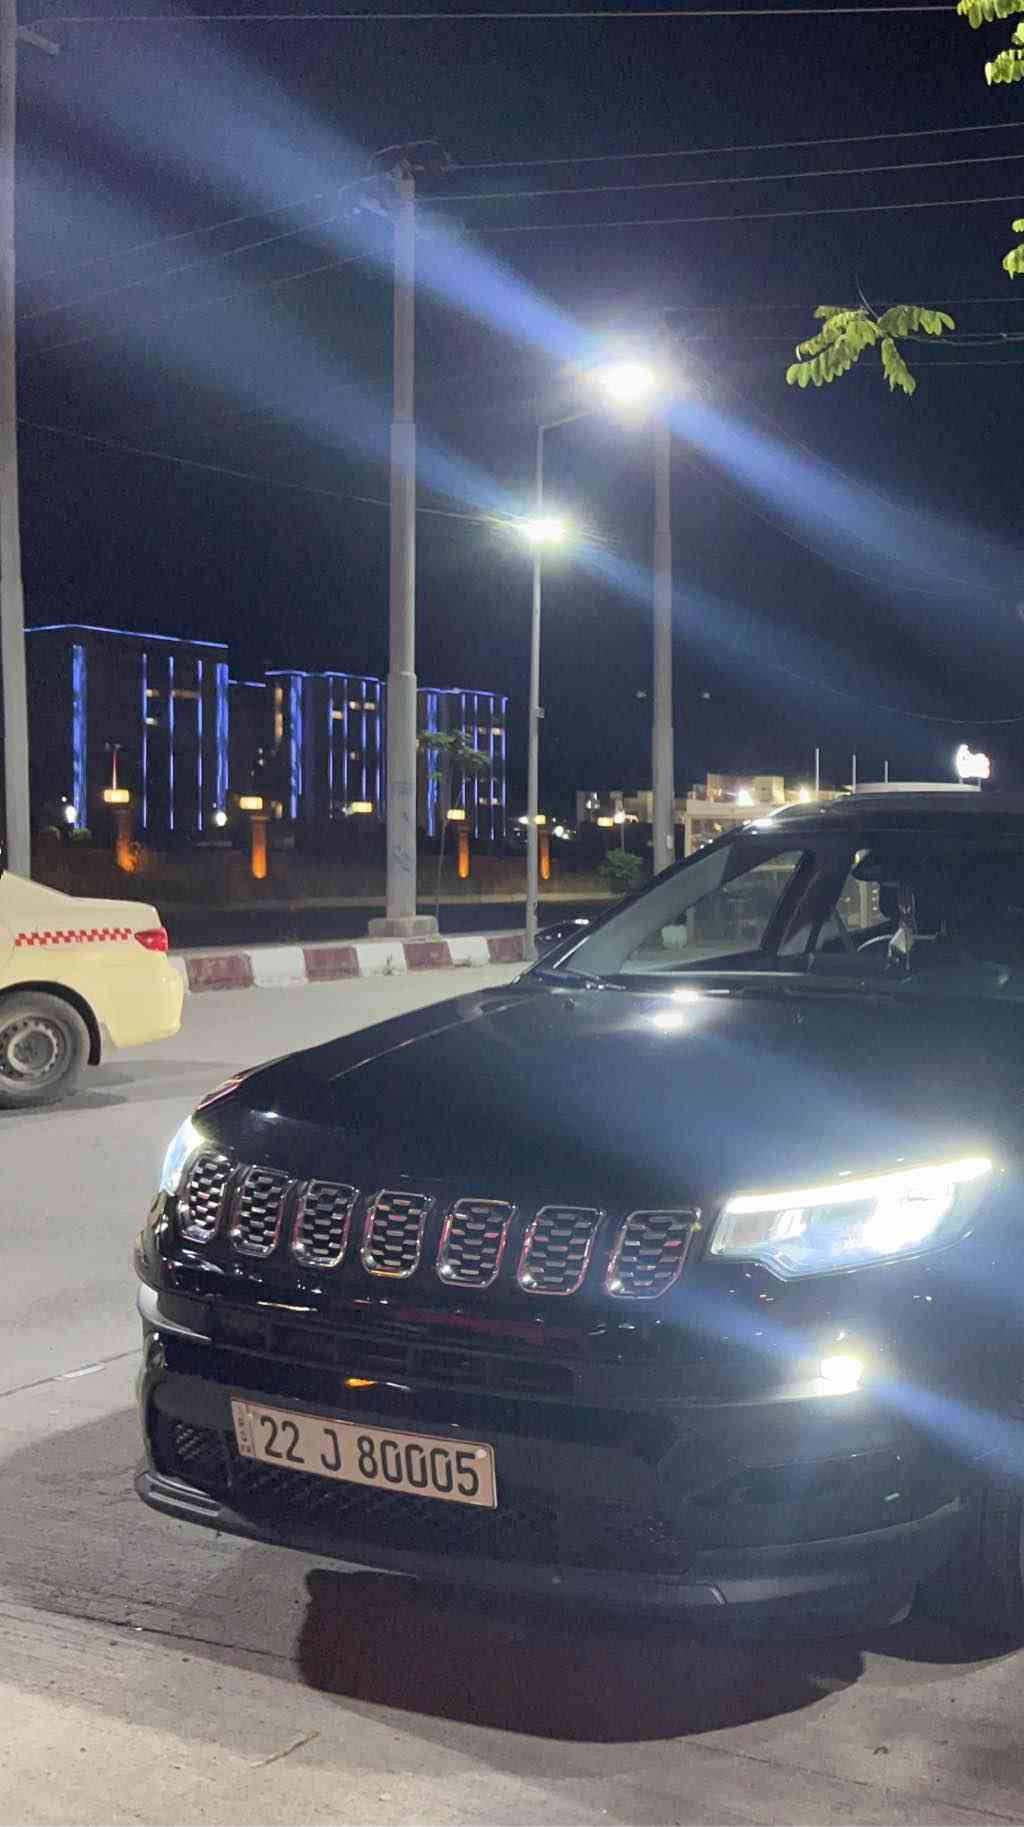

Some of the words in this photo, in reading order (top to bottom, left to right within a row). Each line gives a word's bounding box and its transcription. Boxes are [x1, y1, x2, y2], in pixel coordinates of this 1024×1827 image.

[260, 1415, 305, 1464] 22
[320, 1428, 342, 1472] J
[357, 1435, 480, 1496] 80005
